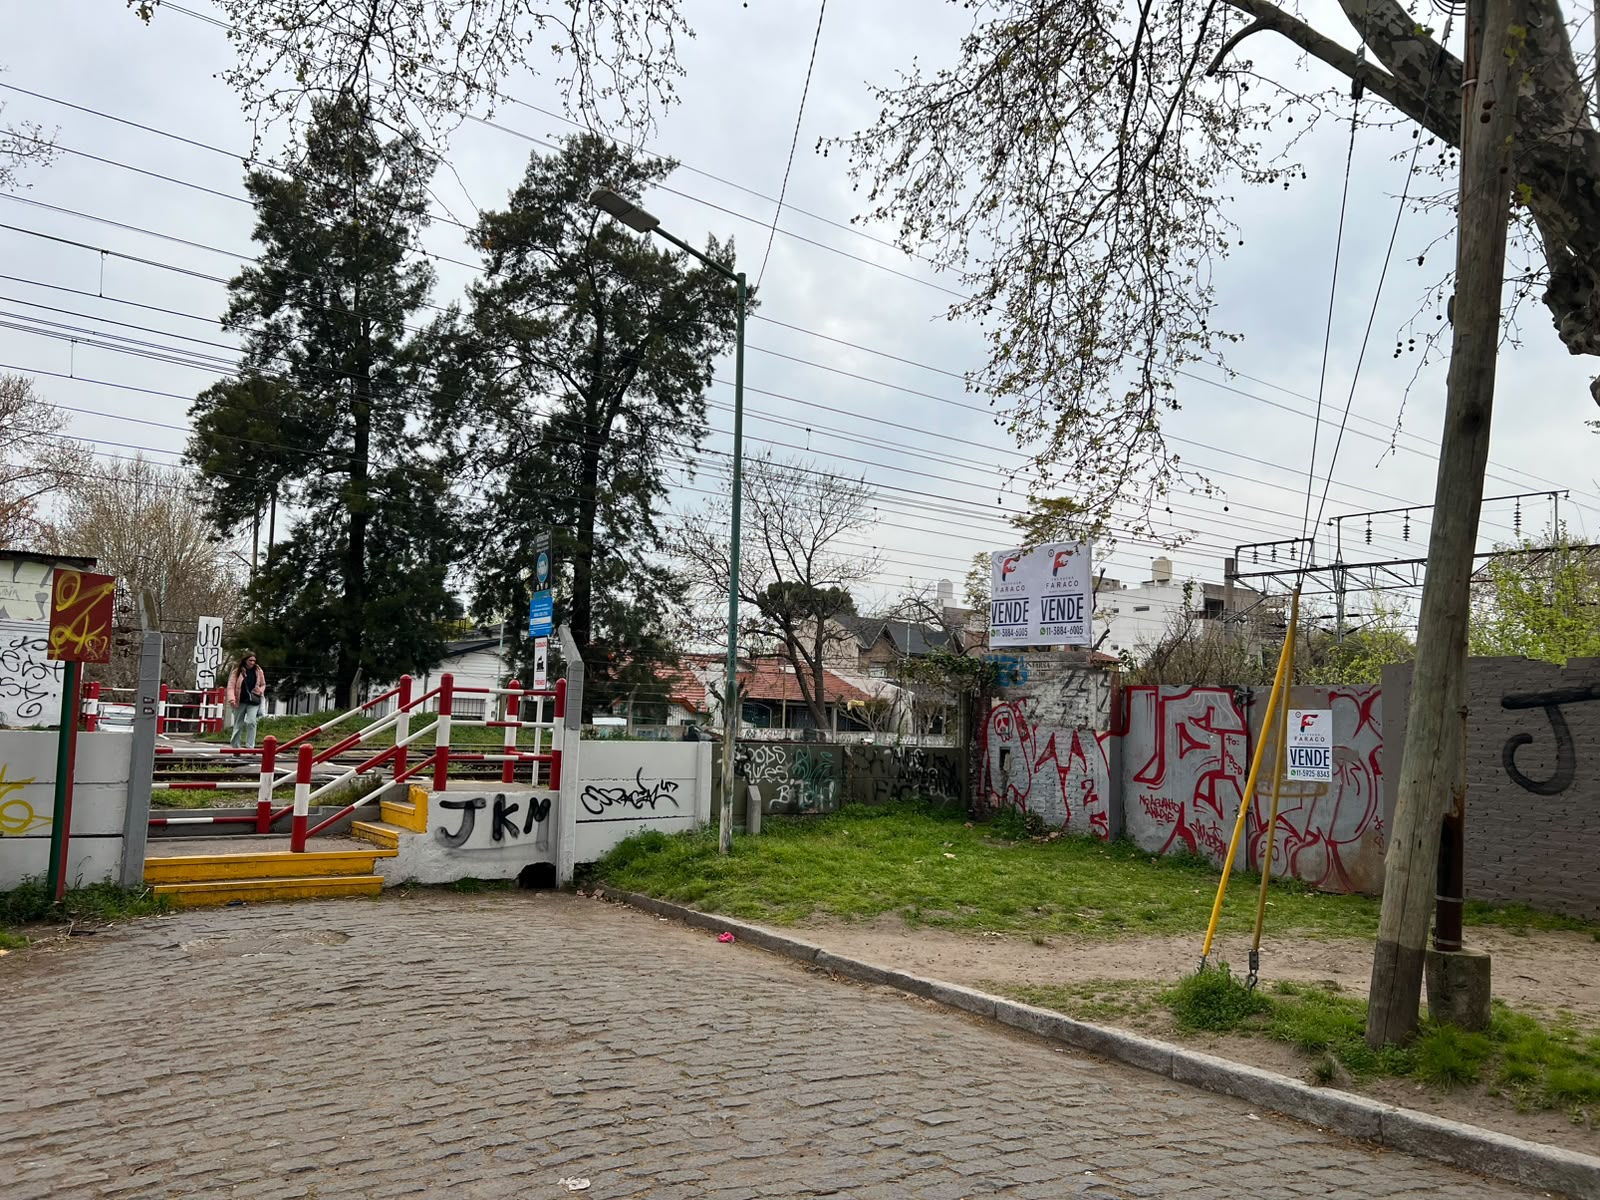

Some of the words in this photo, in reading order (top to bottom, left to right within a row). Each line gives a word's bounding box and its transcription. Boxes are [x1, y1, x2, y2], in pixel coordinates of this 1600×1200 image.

[1045, 580, 1079, 589] FARACO
[991, 600, 1029, 624] VENDE
[1041, 597, 1084, 621] VENDE
[1046, 625, 1084, 636] 11-3884-6005
[1290, 749, 1330, 766] VENDE
